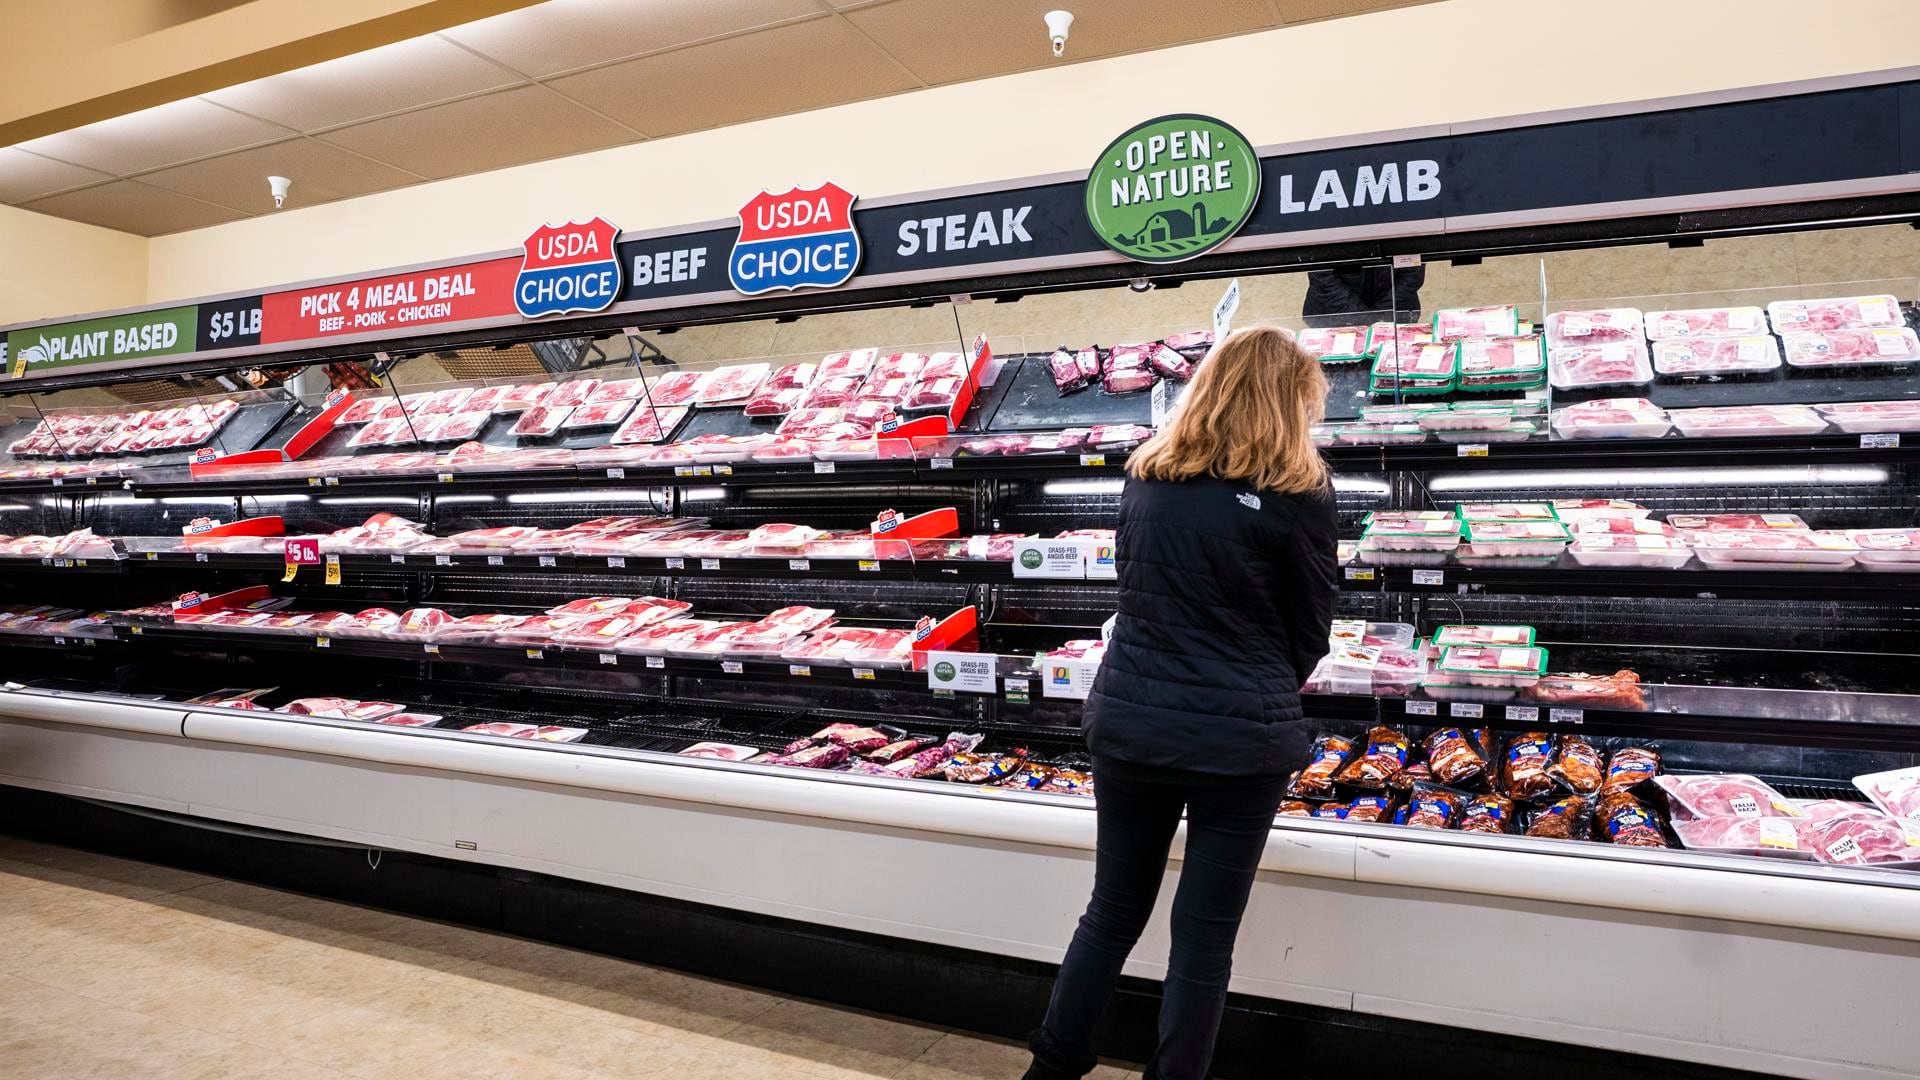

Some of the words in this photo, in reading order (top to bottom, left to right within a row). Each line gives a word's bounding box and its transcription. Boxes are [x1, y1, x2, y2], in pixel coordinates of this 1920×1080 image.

[1126, 130, 1211, 172] OPEN
[1111, 160, 1233, 207] NATURE
[1280, 159, 1441, 215] LAMB
[757, 197, 832, 231] USDA
[897, 205, 1032, 257] STEAK
[537, 230, 600, 260] USDA
[737, 242, 850, 280] CHOICE
[633, 247, 706, 287] BEEF
[300, 292, 341, 318] PICK
[346, 287, 360, 311] 4
[365, 282, 419, 309] MEAL
[424, 272, 476, 300] DEAL
[521, 271, 613, 305] CHOICE
[209, 311, 234, 343] $5
[239, 308, 262, 335] LB
[319, 317, 345, 332] BEEF
[354, 311, 386, 329] PORK
[397, 302, 451, 322] CHICKEN
[50, 331, 108, 362] PLANT
[114, 322, 177, 354] BASED
[288, 543, 301, 561] $5
[303, 547, 317, 561] lb.
[1830, 839, 1854, 854] VALUE
[1835, 844, 1856, 857] PACK
